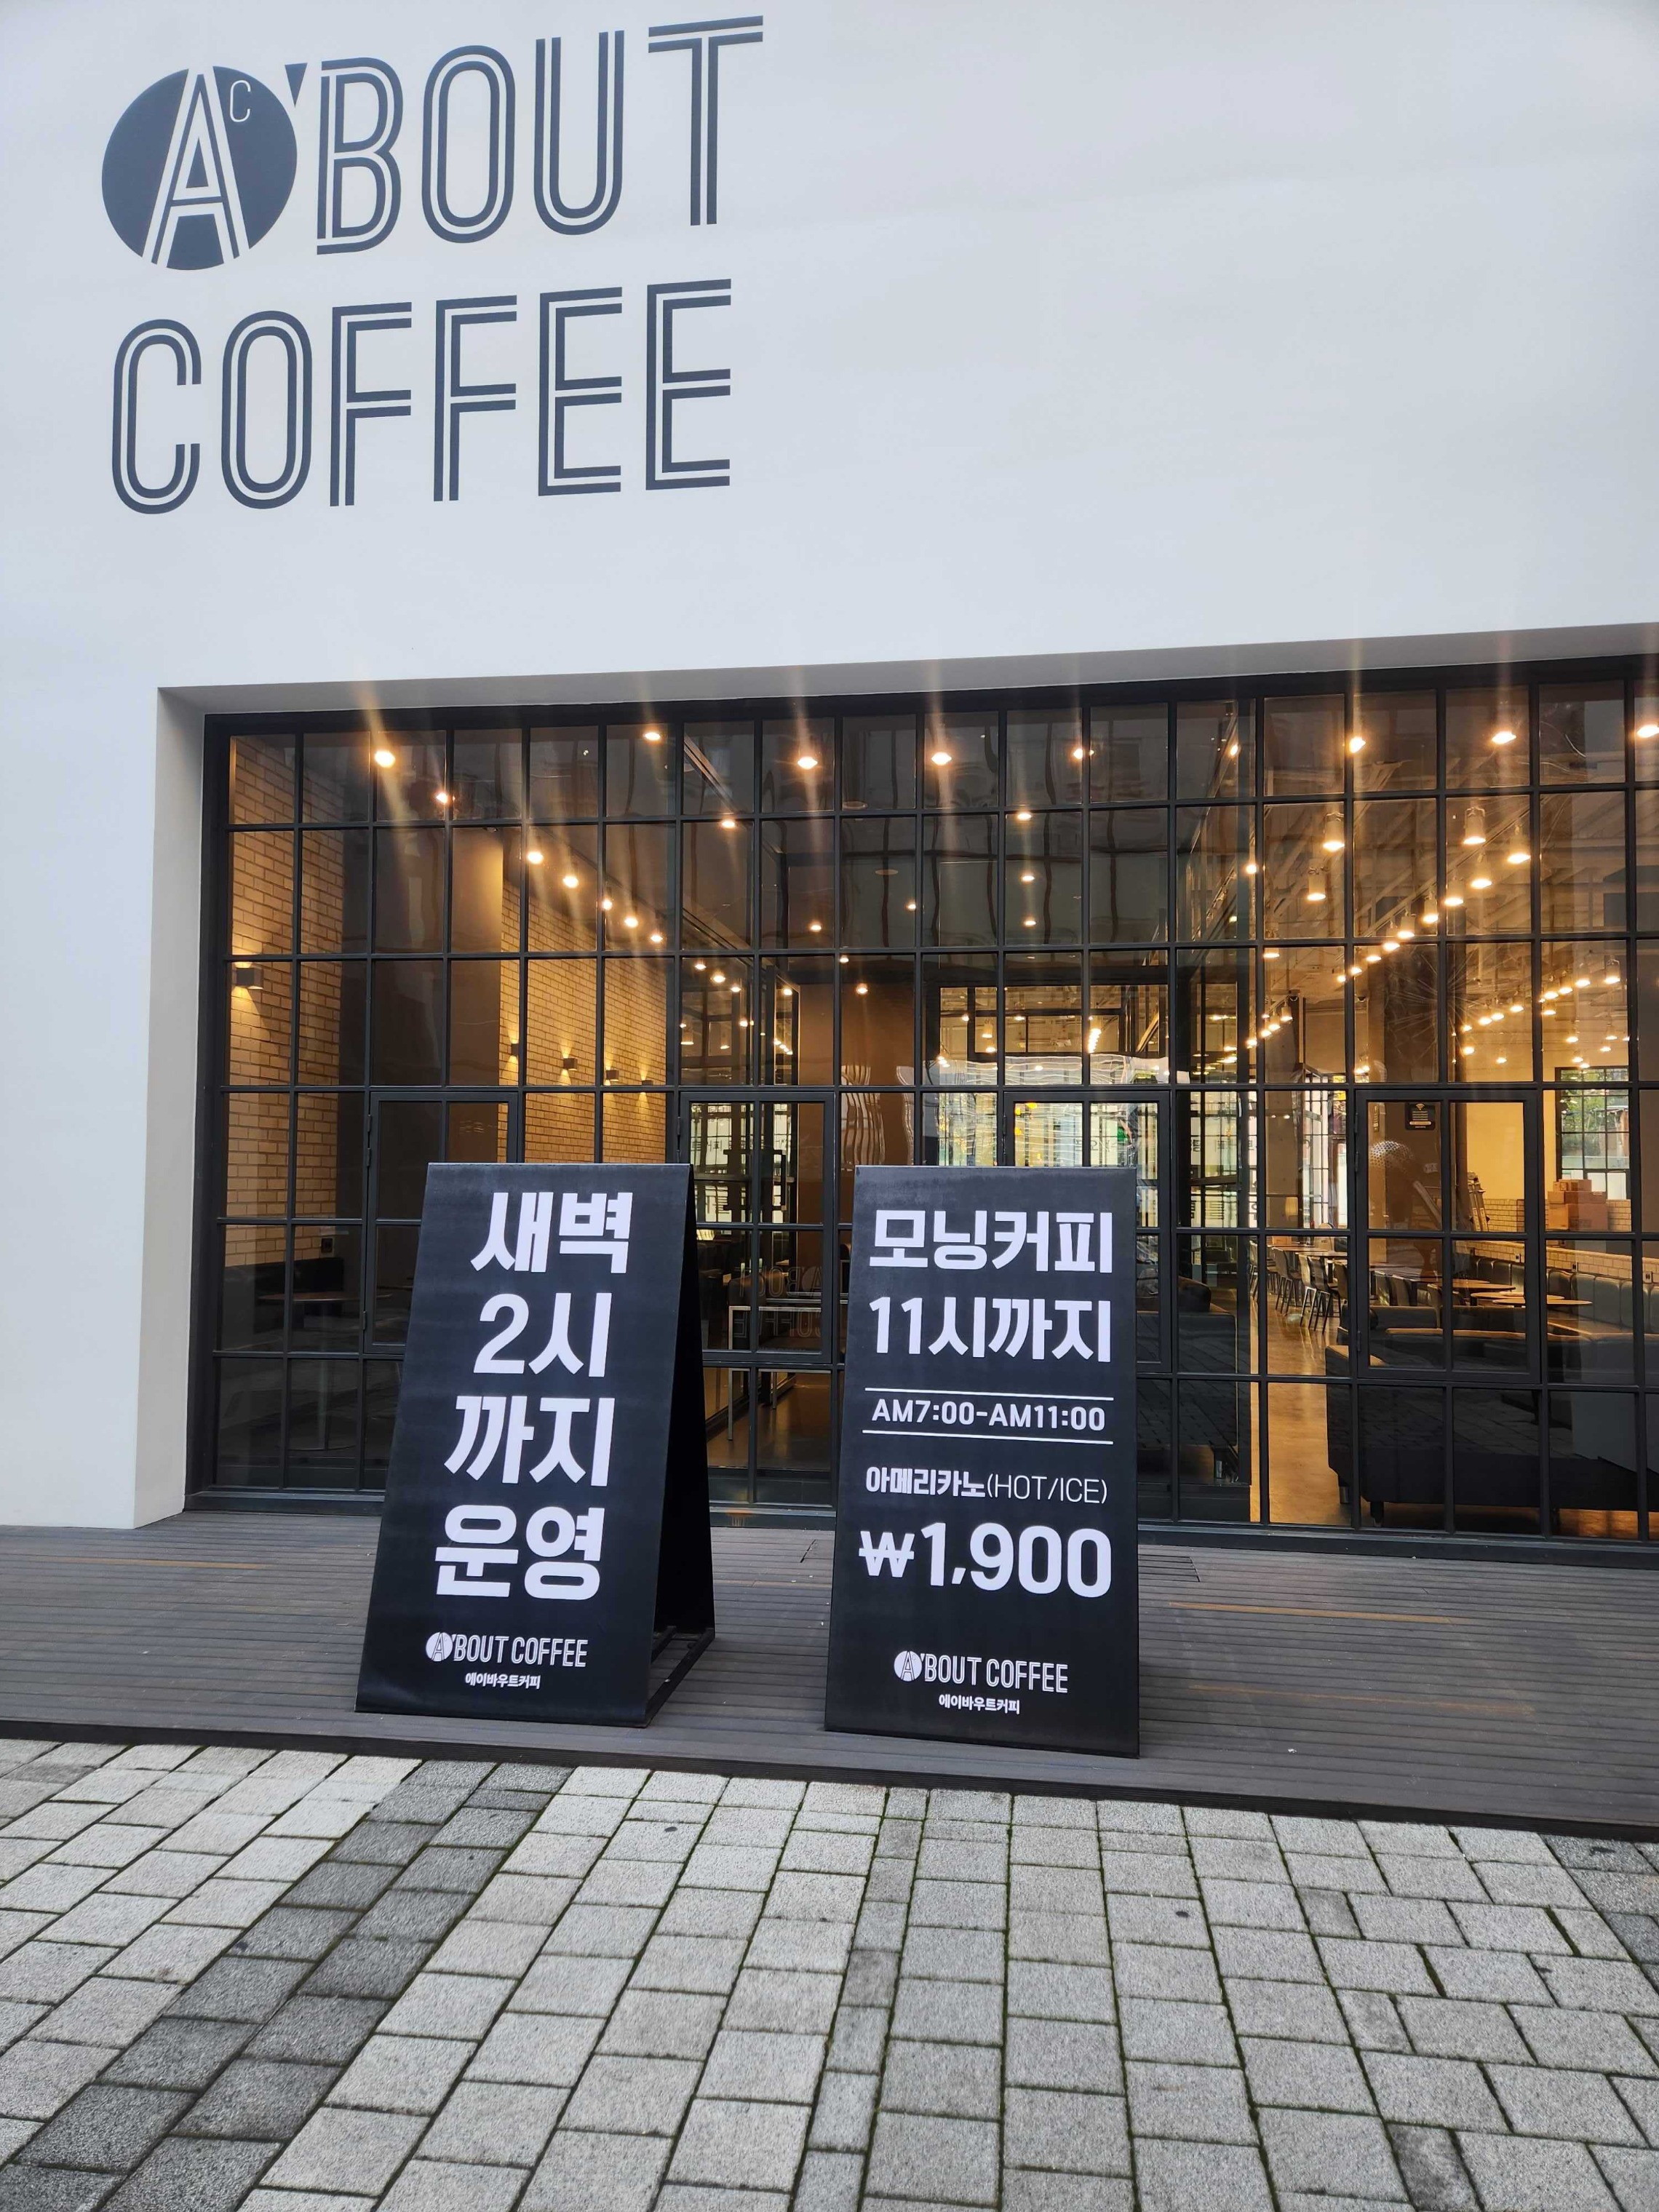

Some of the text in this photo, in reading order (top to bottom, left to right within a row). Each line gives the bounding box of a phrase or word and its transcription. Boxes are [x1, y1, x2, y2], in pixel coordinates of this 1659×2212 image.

[112, 279, 731, 514] COFFEE
[471, 1192, 633, 1274] 새벽
[870, 1210, 1113, 1273] 모닝커피
[474, 1293, 613, 1377] 2시
[870, 1297, 1111, 1363] 11시까지
[444, 1396, 616, 1487] 까지
[871, 1399, 1106, 1431] AM7:00-AM11:00
[866, 1466, 1107, 1504] 아메리카노(HOT/ICE)
[435, 1504, 605, 1601] 운영
[859, 1522, 1112, 1598] ₩1,900
[465, 1672, 541, 1689] 에이바우트커피
[512, 1636, 589, 1667] COFFEE
[987, 1659, 1068, 1693] COFFEE
[939, 1694, 1020, 1715] 에이바우트커피
